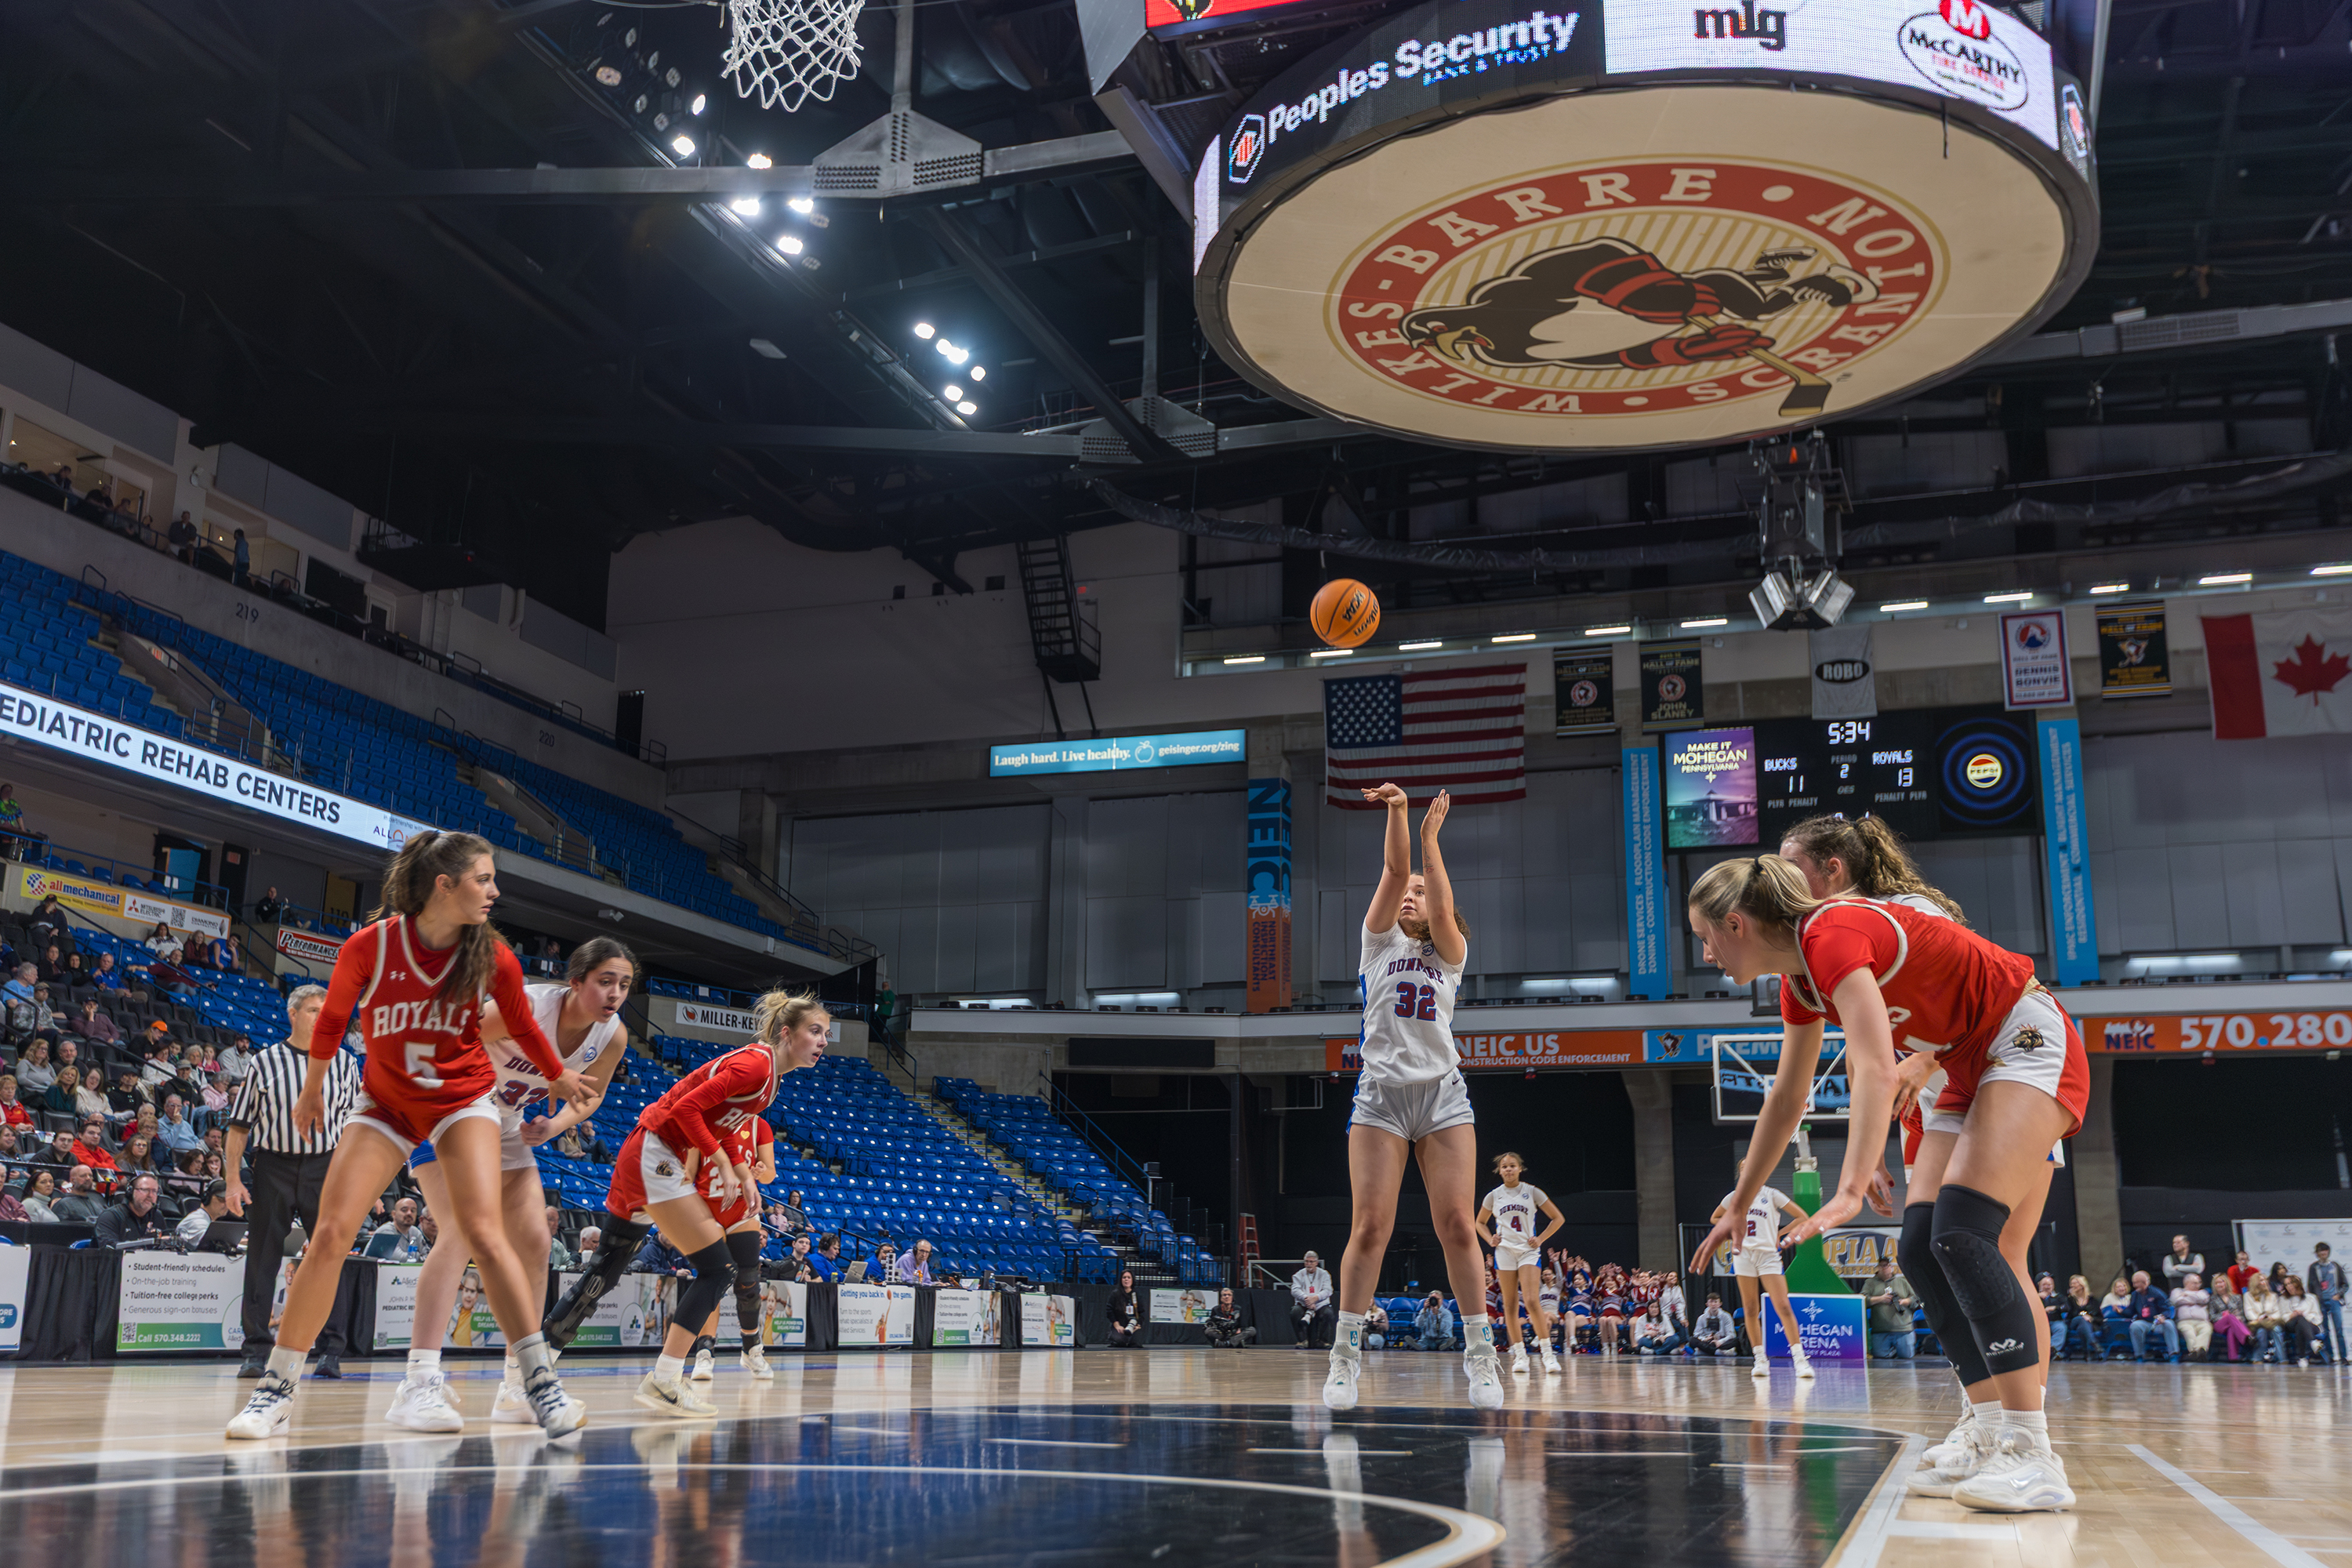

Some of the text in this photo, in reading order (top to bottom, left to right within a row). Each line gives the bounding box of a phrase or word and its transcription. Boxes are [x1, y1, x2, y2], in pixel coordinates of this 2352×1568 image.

[1694, 0, 1786, 52] mlg
[1267, 11, 1580, 143] Peoples Security
[1686, 196, 1926, 403] SCRANTON
[236, 602, 259, 622] 219
[1823, 662, 1864, 681] ROBO
[2015, 666, 2060, 677] DENNIS
[2016, 675, 2061, 687] BONVIE
[1650, 708, 1694, 720] SLANEY
[1657, 702, 1687, 711] JOHN
[539, 729, 555, 747] 220
[1828, 721, 1871, 745] 5:34
[1158, 741, 1240, 757] geisinger.org/zing
[1687, 741, 1732, 753] MAKE IT
[994, 748, 1131, 768] Laugh hard. Live healthy.
[1673, 749, 1748, 766] MOHEGAN
[1764, 757, 1798, 772] BUCKS
[1831, 754, 1857, 765] PERIOD
[1872, 749, 1914, 765] ROYALS
[1681, 761, 1740, 774] PENNSYLVANIA
[1839, 764, 1849, 779] 2
[141, 739, 230, 789] REHAB
[236, 771, 340, 824] CENTERS
[1789, 775, 1804, 793] 11
[1898, 767, 1914, 787] 13
[1788, 797, 1819, 808] PENALTY
[1875, 792, 1905, 803] PENALTY
[1248, 778, 1282, 895] NEIC
[1631, 753, 1646, 975] DRONE SERVICES FLOODPLAIN MANAGEMENT
[1641, 753, 1657, 974] ZONING CONSTRUCTION CODE ENFORCEMENT
[191, 916, 219, 927] DIAMOND
[280, 931, 338, 959] PERFORMANCE
[1252, 921, 1261, 993] CONSULTANTS
[1387, 957, 1444, 985] DUNMRE
[1394, 981, 1436, 1022] 32
[1454, 1033, 1560, 1058] NEIC.US
[2104, 1033, 2155, 1051] NEIC
[404, 1041, 445, 1090] 5
[1458, 1053, 1632, 1067] ONSTRUCTION CODE ENFORCEMENT
[1510, 1215, 1523, 1232] 4
[1747, 1219, 1757, 1237] 2
[1827, 1236, 1899, 1266] PIAA
[133, 1263, 226, 1273] Student-friendly schedules
[131, 1277, 197, 1287] On-the-job training
[130, 1291, 219, 1301] Tuition-free college perks
[840, 1289, 858, 1299] Getting
[128, 1305, 162, 1314] Generous
[163, 1306, 191, 1316] sign-on
[137, 1334, 152, 1343] Call
[1774, 1323, 1853, 1337] MHEGAN
[1787, 1337, 1841, 1349] RENA
